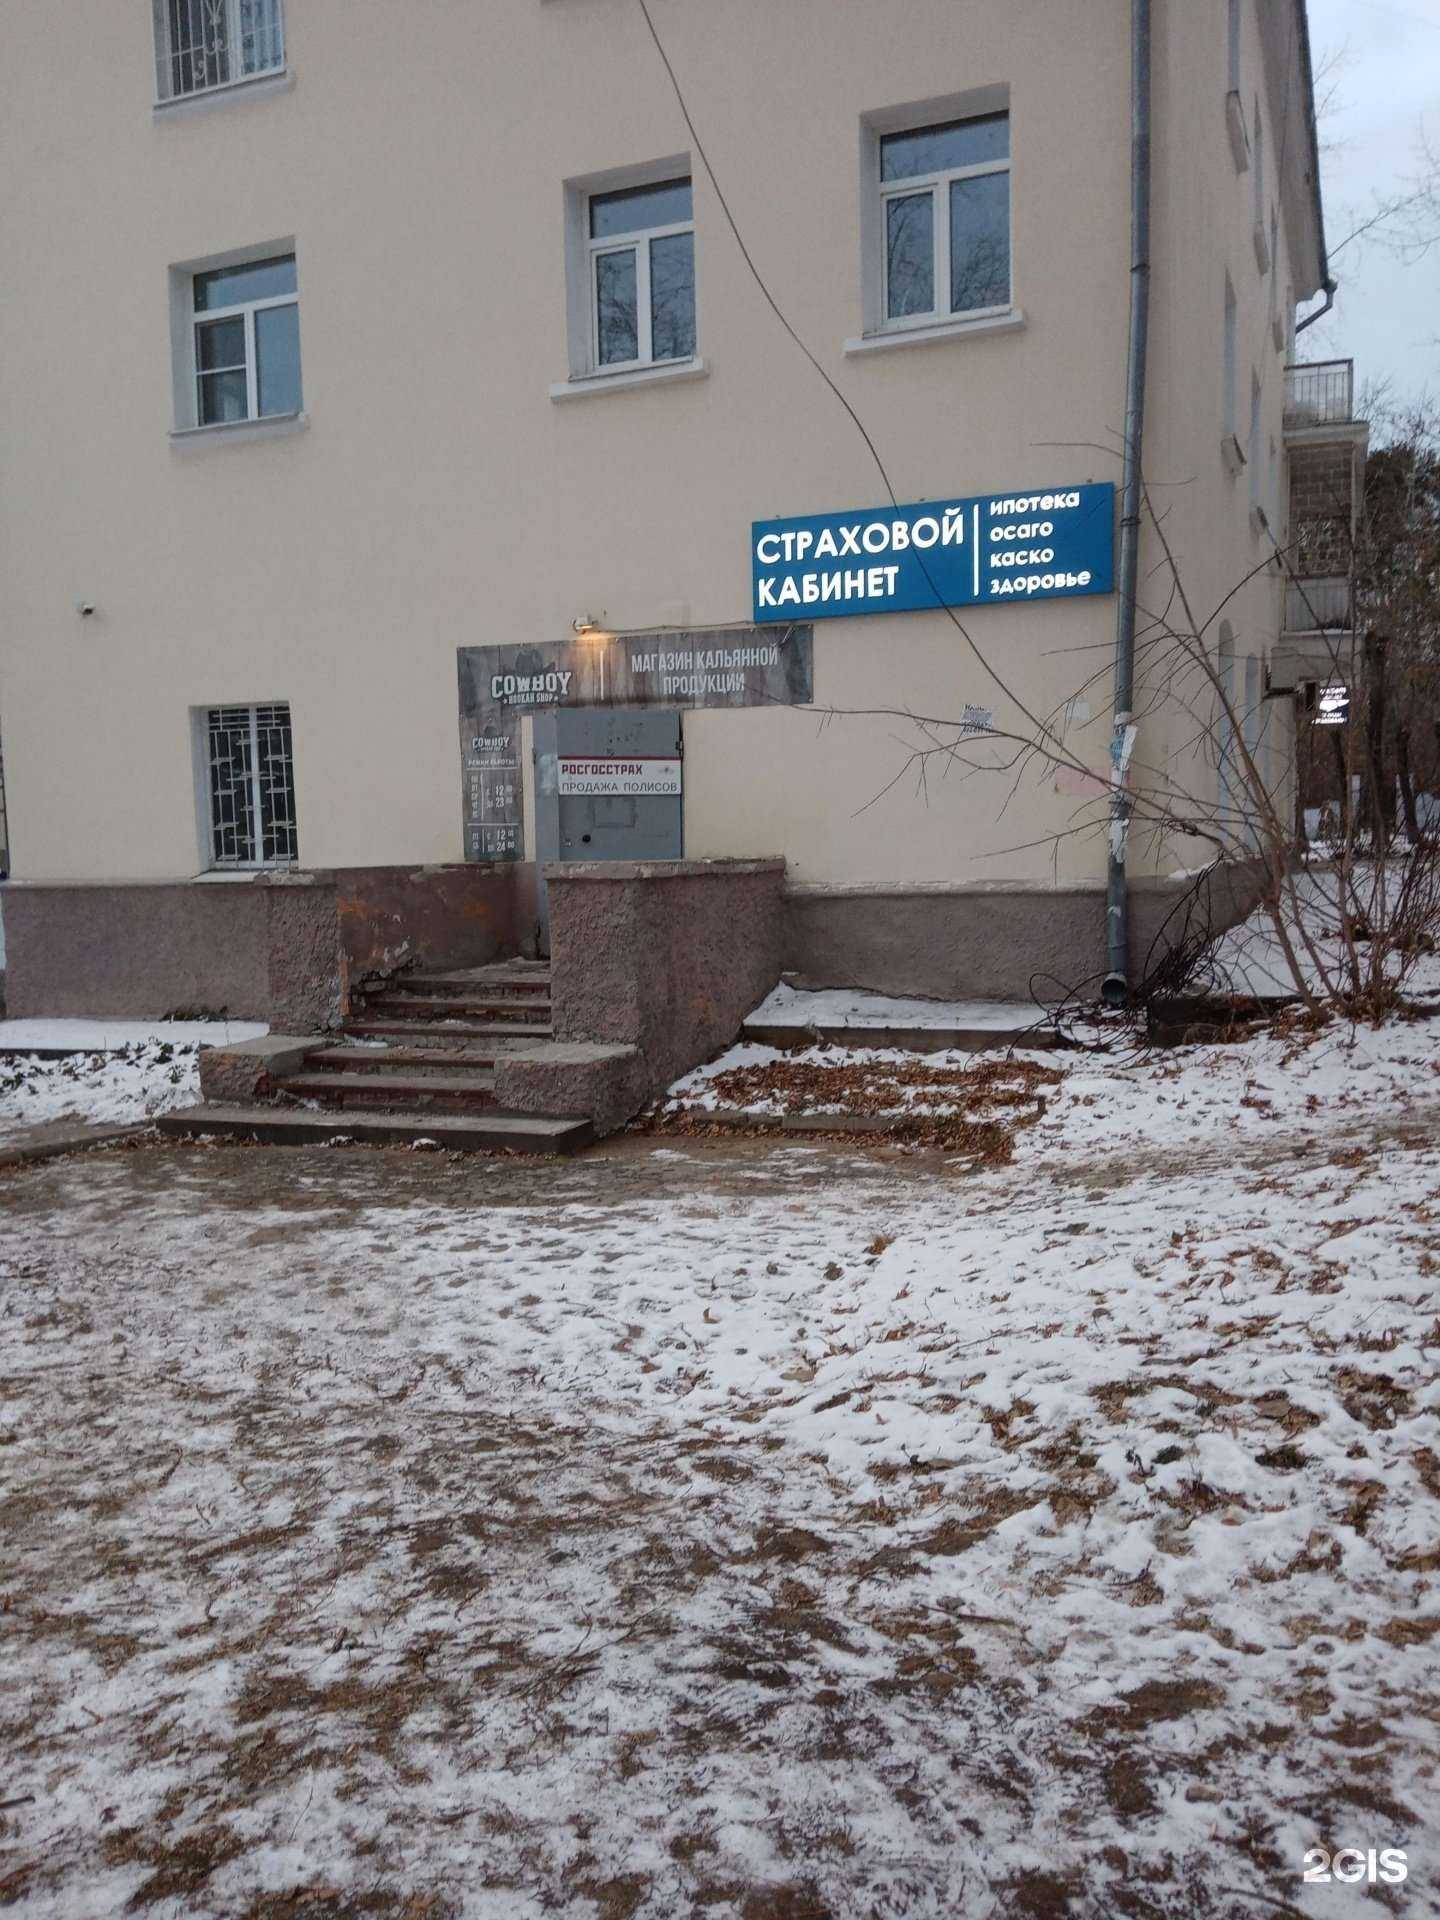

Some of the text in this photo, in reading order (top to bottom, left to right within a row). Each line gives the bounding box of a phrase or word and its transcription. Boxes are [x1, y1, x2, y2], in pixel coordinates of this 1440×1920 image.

[990, 491, 1080, 516] ипотека
[757, 507, 964, 564] СТРАХОВОЙ
[990, 521, 1054, 542] осаго
[990, 548, 1054, 568] каско
[758, 566, 899, 607] КАБИНЕТ
[990, 570, 1092, 595] здоровье
[631, 643, 778, 673] МАГАЗИН КАЛЬЯННОЙ
[663, 672, 745, 695] ПРОДУКЦИИ
[561, 764, 643, 775] РОСГОССТРАХ
[562, 782, 677, 793] ПРОДАЖА ПОЛИСОВ
